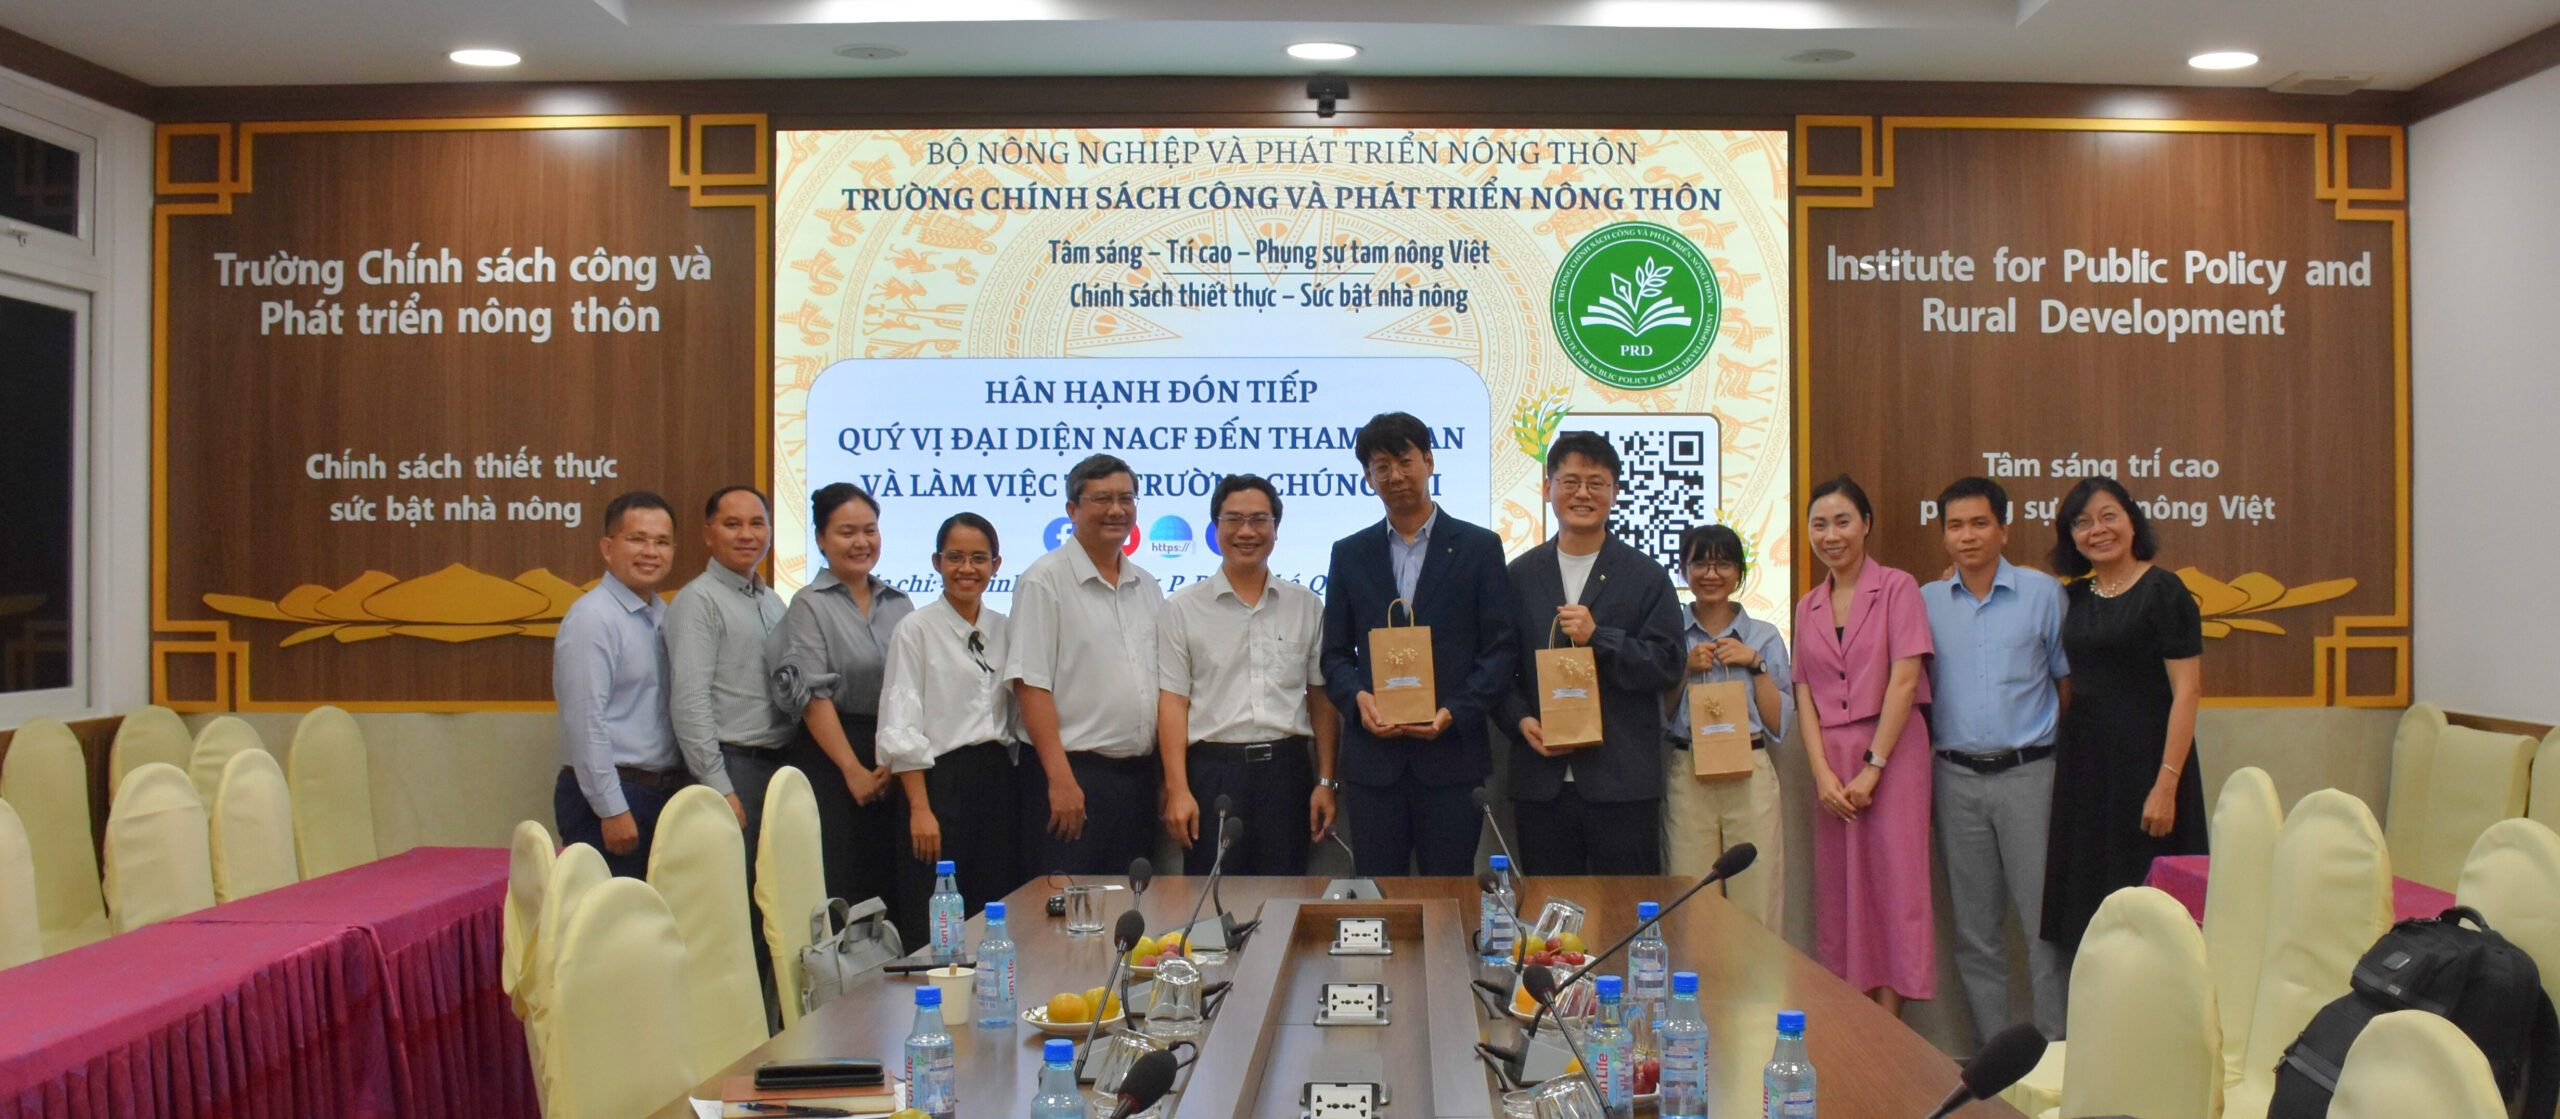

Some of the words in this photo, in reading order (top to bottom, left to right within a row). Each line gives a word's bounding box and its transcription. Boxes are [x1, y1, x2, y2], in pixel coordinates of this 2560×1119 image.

[927, 137, 969, 171] BỘ
[978, 137, 1069, 165] NÔNG
[1079, 136, 1200, 171] NGHIỆP
[1207, 136, 1248, 164] VÀ
[1256, 135, 1337, 164] PHÁT
[1346, 132, 1439, 164] TRIỂN
[1448, 137, 1541, 165] NÔNG
[1549, 137, 1638, 165] THÔN
[842, 181, 974, 211] TRƯỜNG
[981, 181, 1087, 210] CHÍNH
[1096, 181, 1180, 210] SÁCH
[1189, 181, 1277, 210] CÔNG
[1285, 180, 1326, 210] VÀ
[1336, 180, 1422, 210] PHÁT
[1426, 176, 1522, 210] TRIỂN
[1531, 181, 1624, 210] NÔNG
[1631, 181, 1722, 210] THÔN
[214, 249, 343, 295] Trường
[357, 242, 463, 285] Chính
[477, 247, 556, 284] sách
[569, 248, 657, 292] công
[670, 246, 711, 281] và
[1049, 239, 1090, 264] Tâm
[1096, 240, 1142, 270] sáng
[1166, 239, 1194, 264] Trí
[1199, 244, 1232, 264] cao
[1256, 239, 1317, 270] Phụng
[1322, 242, 1350, 270] sự
[1351, 243, 1389, 264] tam
[1394, 240, 1444, 270] nông
[1450, 239, 1490, 270] Việt
[1827, 245, 1975, 283] Institute
[1993, 247, 2046, 283] for
[2063, 248, 2168, 285] Public
[2185, 250, 2287, 296] Policy
[2306, 252, 2372, 287] and
[1071, 282, 1124, 308] Chính
[1129, 283, 1173, 308] sách
[1178, 283, 1226, 308] thiết
[1232, 284, 1276, 313] thực
[1301, 282, 1334, 308] Sức
[1340, 283, 1373, 313] bật
[1379, 283, 1411, 308] nhà
[1418, 284, 1468, 313] nông
[261, 298, 344, 336] Phát
[357, 291, 444, 335] triển
[458, 297, 552, 343] nông
[572, 297, 660, 334] thôn
[1922, 297, 2016, 334] Rural
[2041, 299, 2285, 342] Development
[1620, 344, 1653, 357] PRD
[985, 375, 1056, 404] HÂN
[1064, 380, 1159, 410] HẠNH
[1169, 375, 1239, 404] ĐÓN
[1247, 369, 1318, 404] TIẾP
[1618, 375, 1649, 384] POLICY
[838, 422, 904, 456] QUÝ
[911, 427, 942, 457] VỊ
[951, 427, 1008, 457] ĐẠI
[1016, 421, 1097, 457] DIỆN
[1104, 427, 1187, 451] NACF
[1195, 416, 1262, 450] ĐẾN
[306, 446, 387, 480] Chính
[398, 452, 463, 480] sách
[475, 446, 542, 480] thiết
[553, 452, 618, 486] thực
[1982, 452, 2040, 478] Tâm
[2128, 448, 2161, 478] trí
[2170, 457, 2220, 479] cao
[861, 468, 904, 497] VÀ
[910, 468, 976, 497] LÀM
[984, 468, 1057, 503] VIỆC
[330, 495, 377, 523] sức
[386, 495, 435, 528] bật
[444, 495, 498, 522] nhà
[508, 496, 582, 528] nông
[2024, 498, 2059, 527] sự
[2219, 495, 2275, 525] Việt
[1151, 542, 1190, 555] https://
[1596, 1053, 1609, 1079] Life
